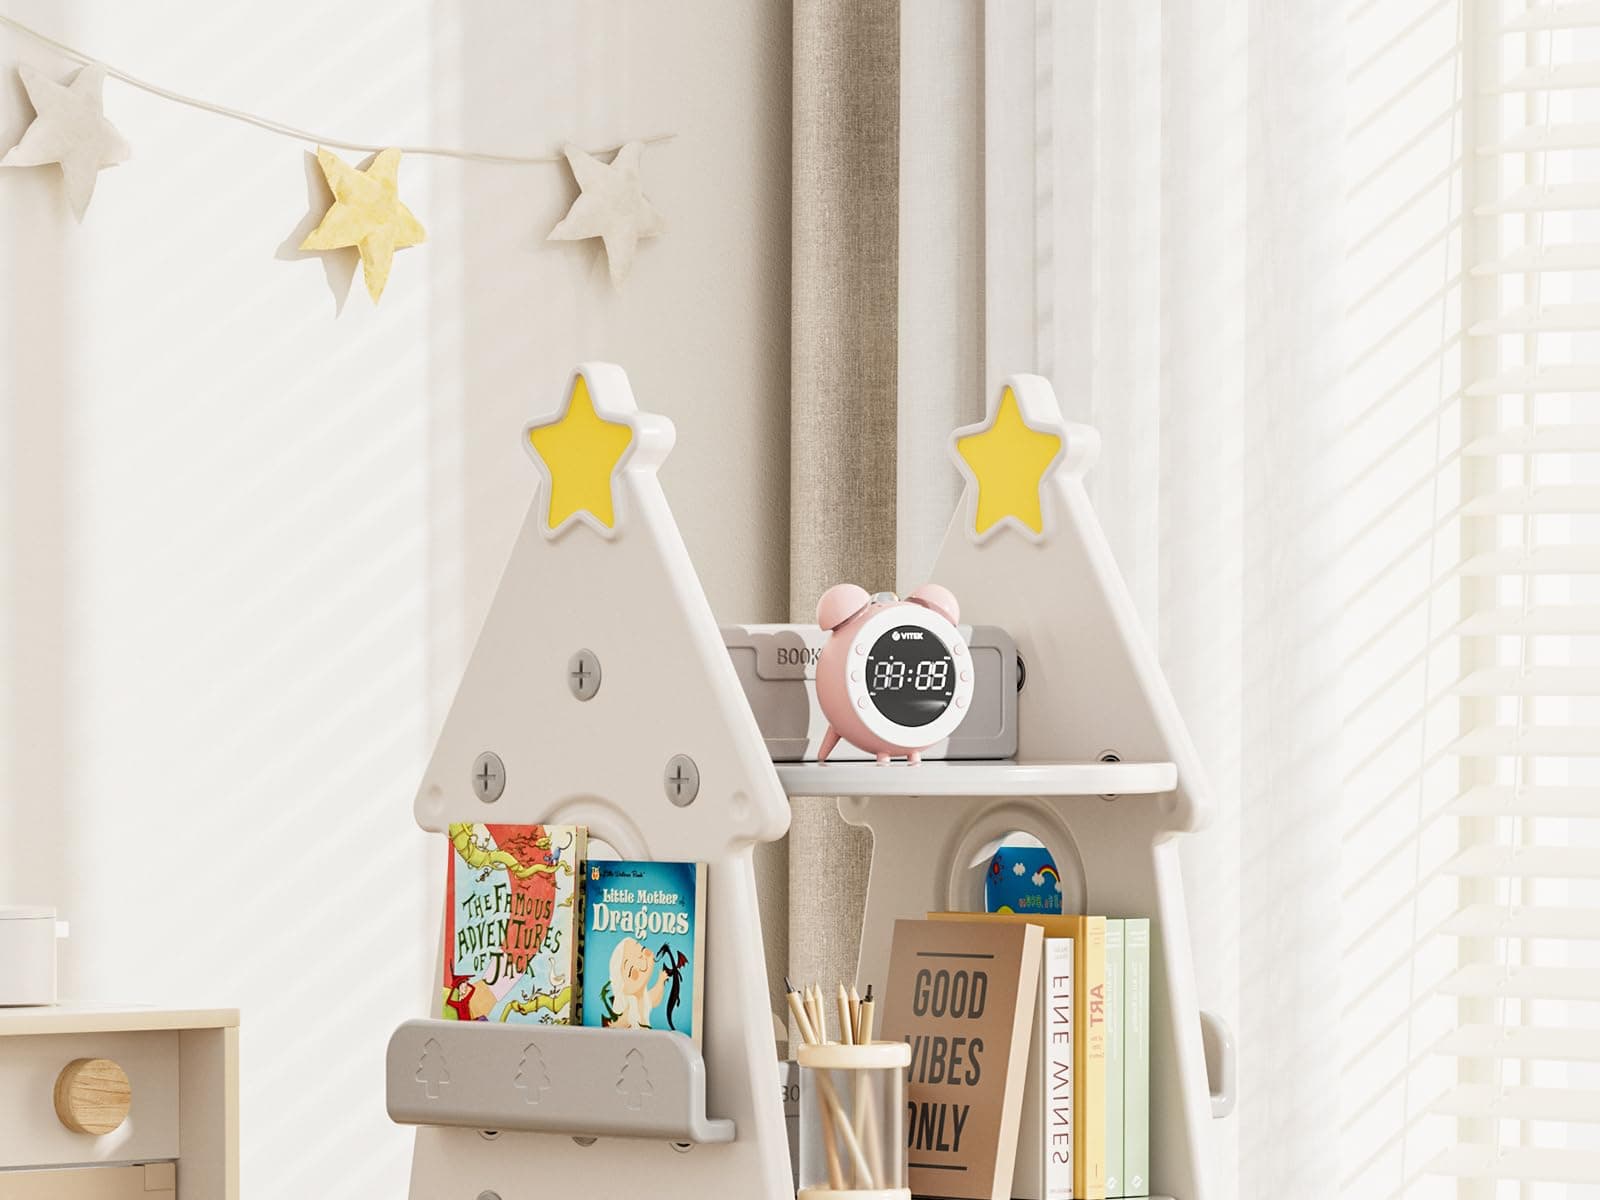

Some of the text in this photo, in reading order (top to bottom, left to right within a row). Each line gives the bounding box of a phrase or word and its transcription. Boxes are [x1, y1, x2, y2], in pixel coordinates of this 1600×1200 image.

[901, 632, 923, 640] VITEK
[462, 883, 552, 920] THE FAMOUS
[603, 888, 678, 905] Little Mother
[592, 903, 689, 940] Dragons
[457, 918, 562, 963] ADVENTURES
[473, 951, 537, 985] OF JACK
[913, 968, 988, 1019] GOOD
[905, 1034, 984, 1086] VIBES
